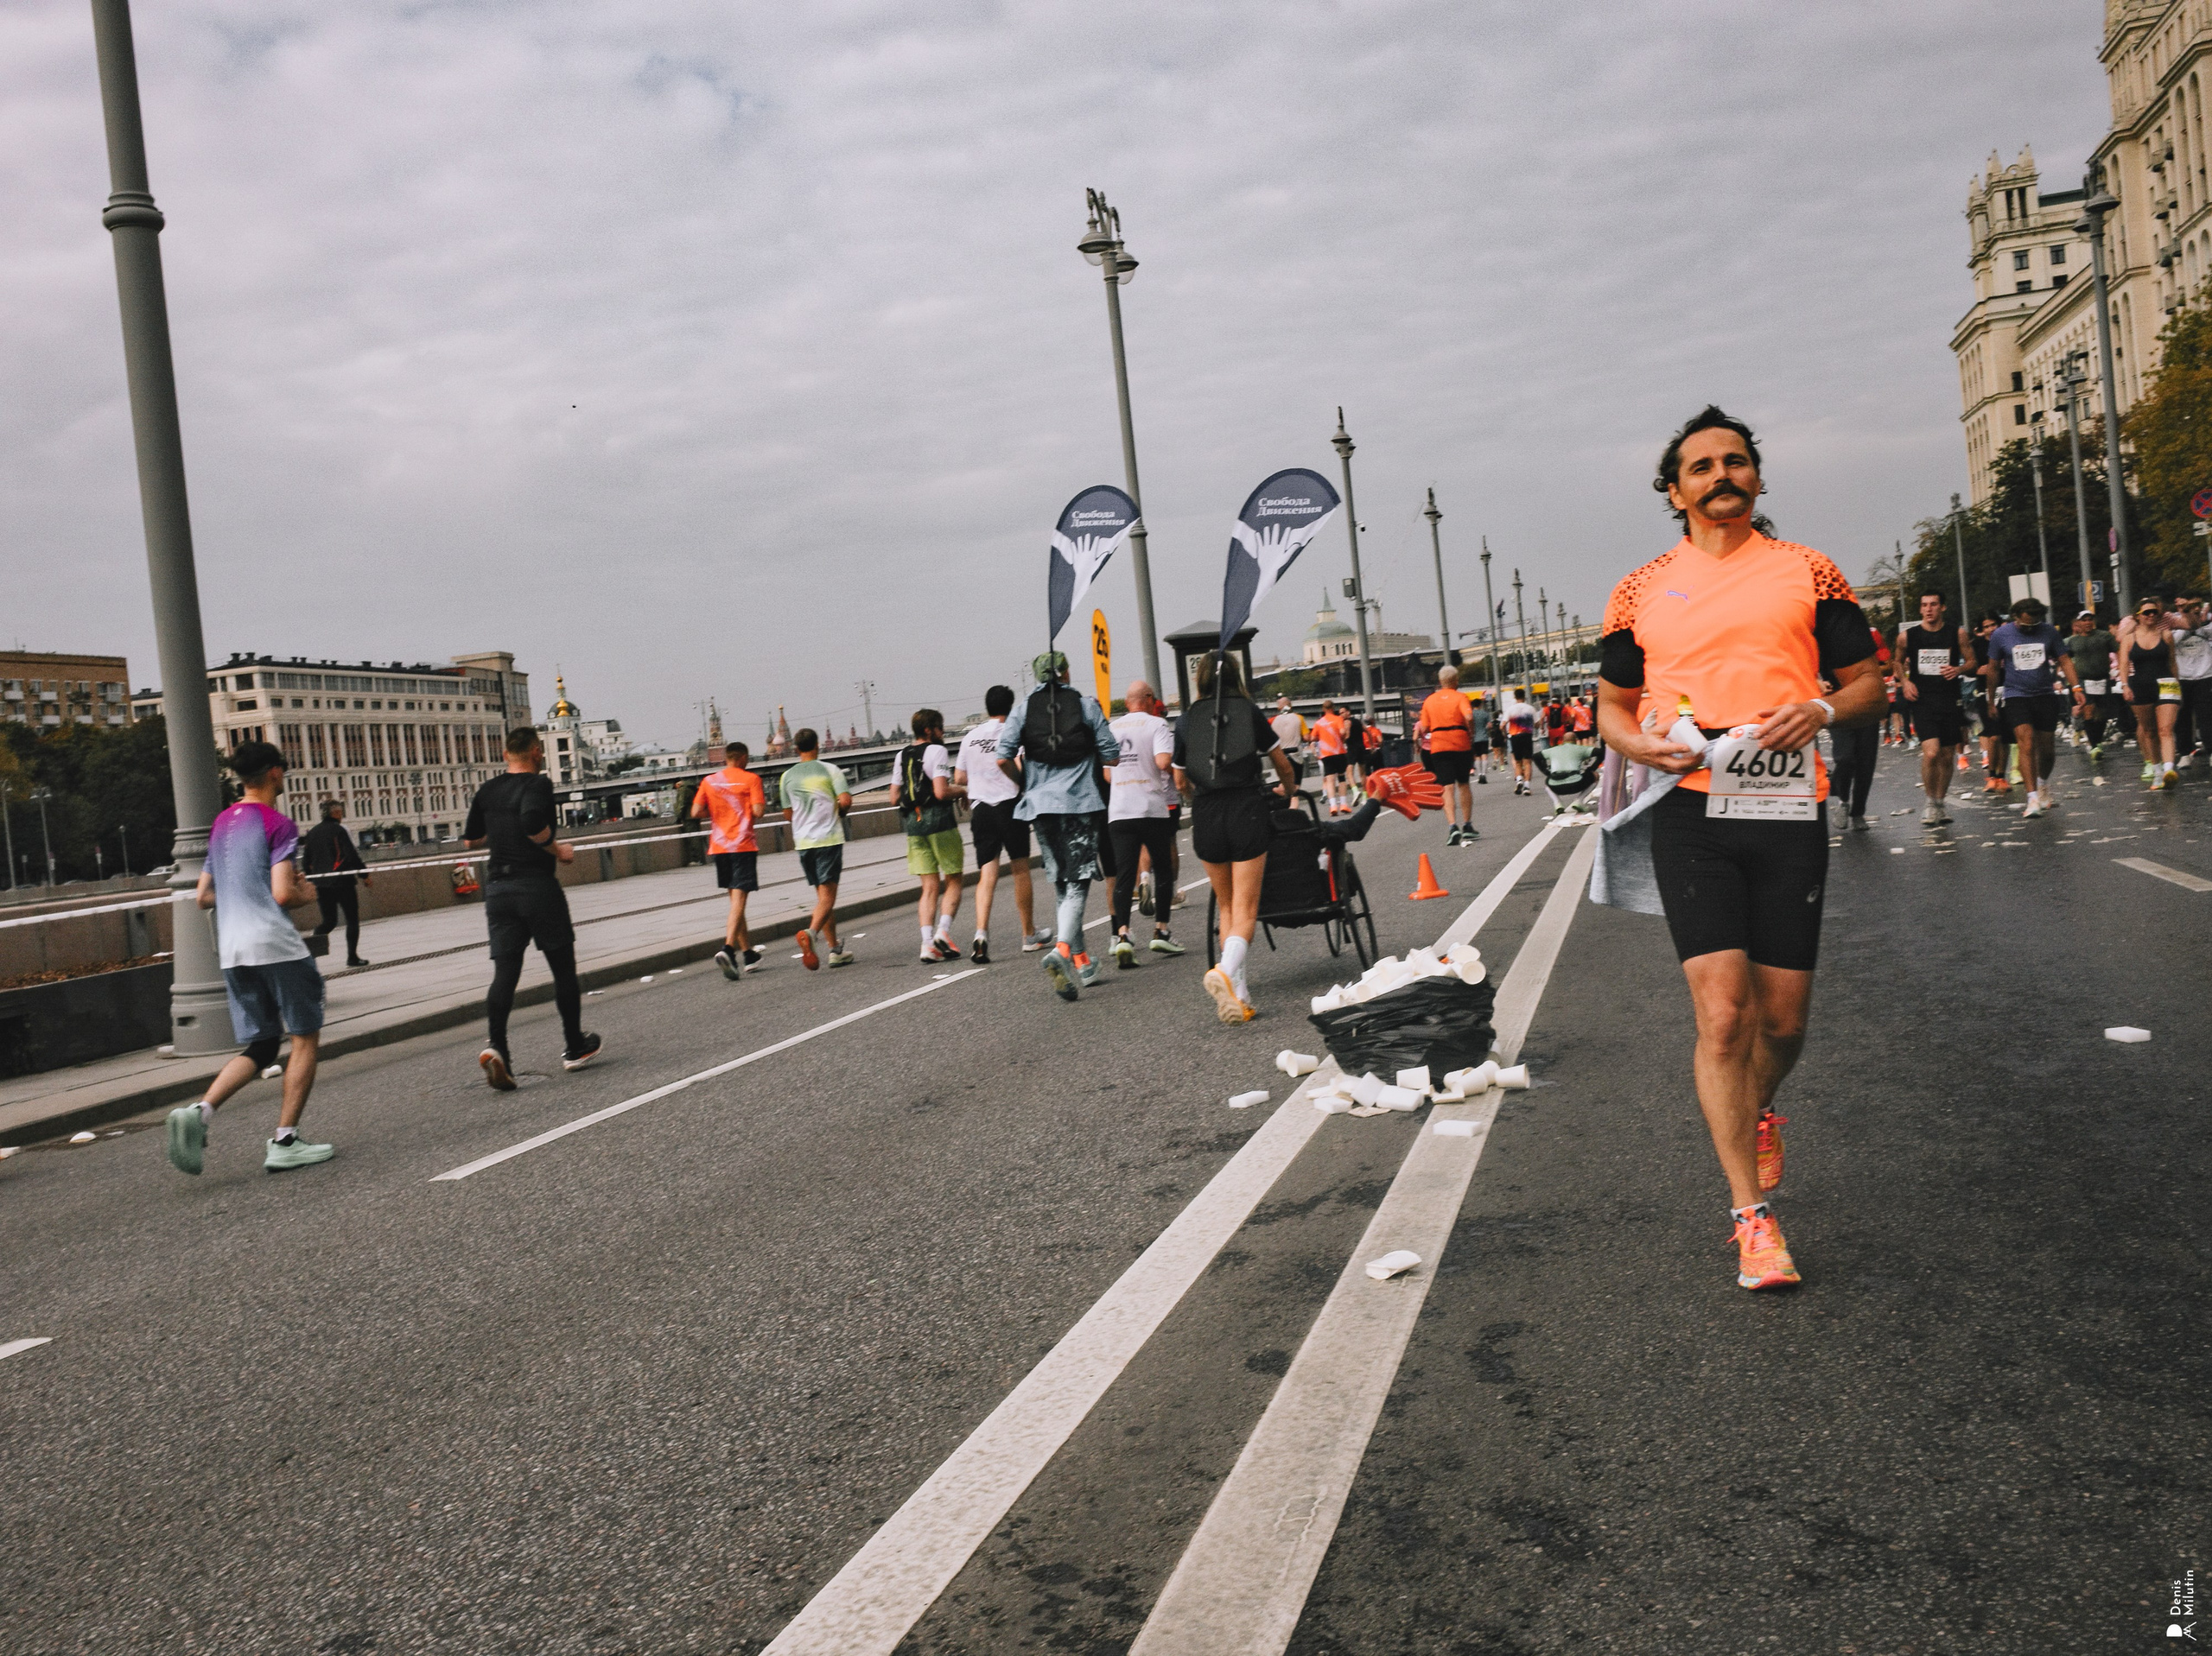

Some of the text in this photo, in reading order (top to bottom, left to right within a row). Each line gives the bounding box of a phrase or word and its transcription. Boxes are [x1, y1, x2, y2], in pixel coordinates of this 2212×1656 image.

[1257, 496, 1311, 507] Свобода
[1071, 510, 1116, 518] Свобода
[1256, 505, 1323, 517] Движения
[1071, 518, 1126, 528] Движения
[969, 739, 998, 747] SPORT
[1726, 749, 1806, 778] 4602
[1738, 781, 1790, 790] ВЛАДИМИР
